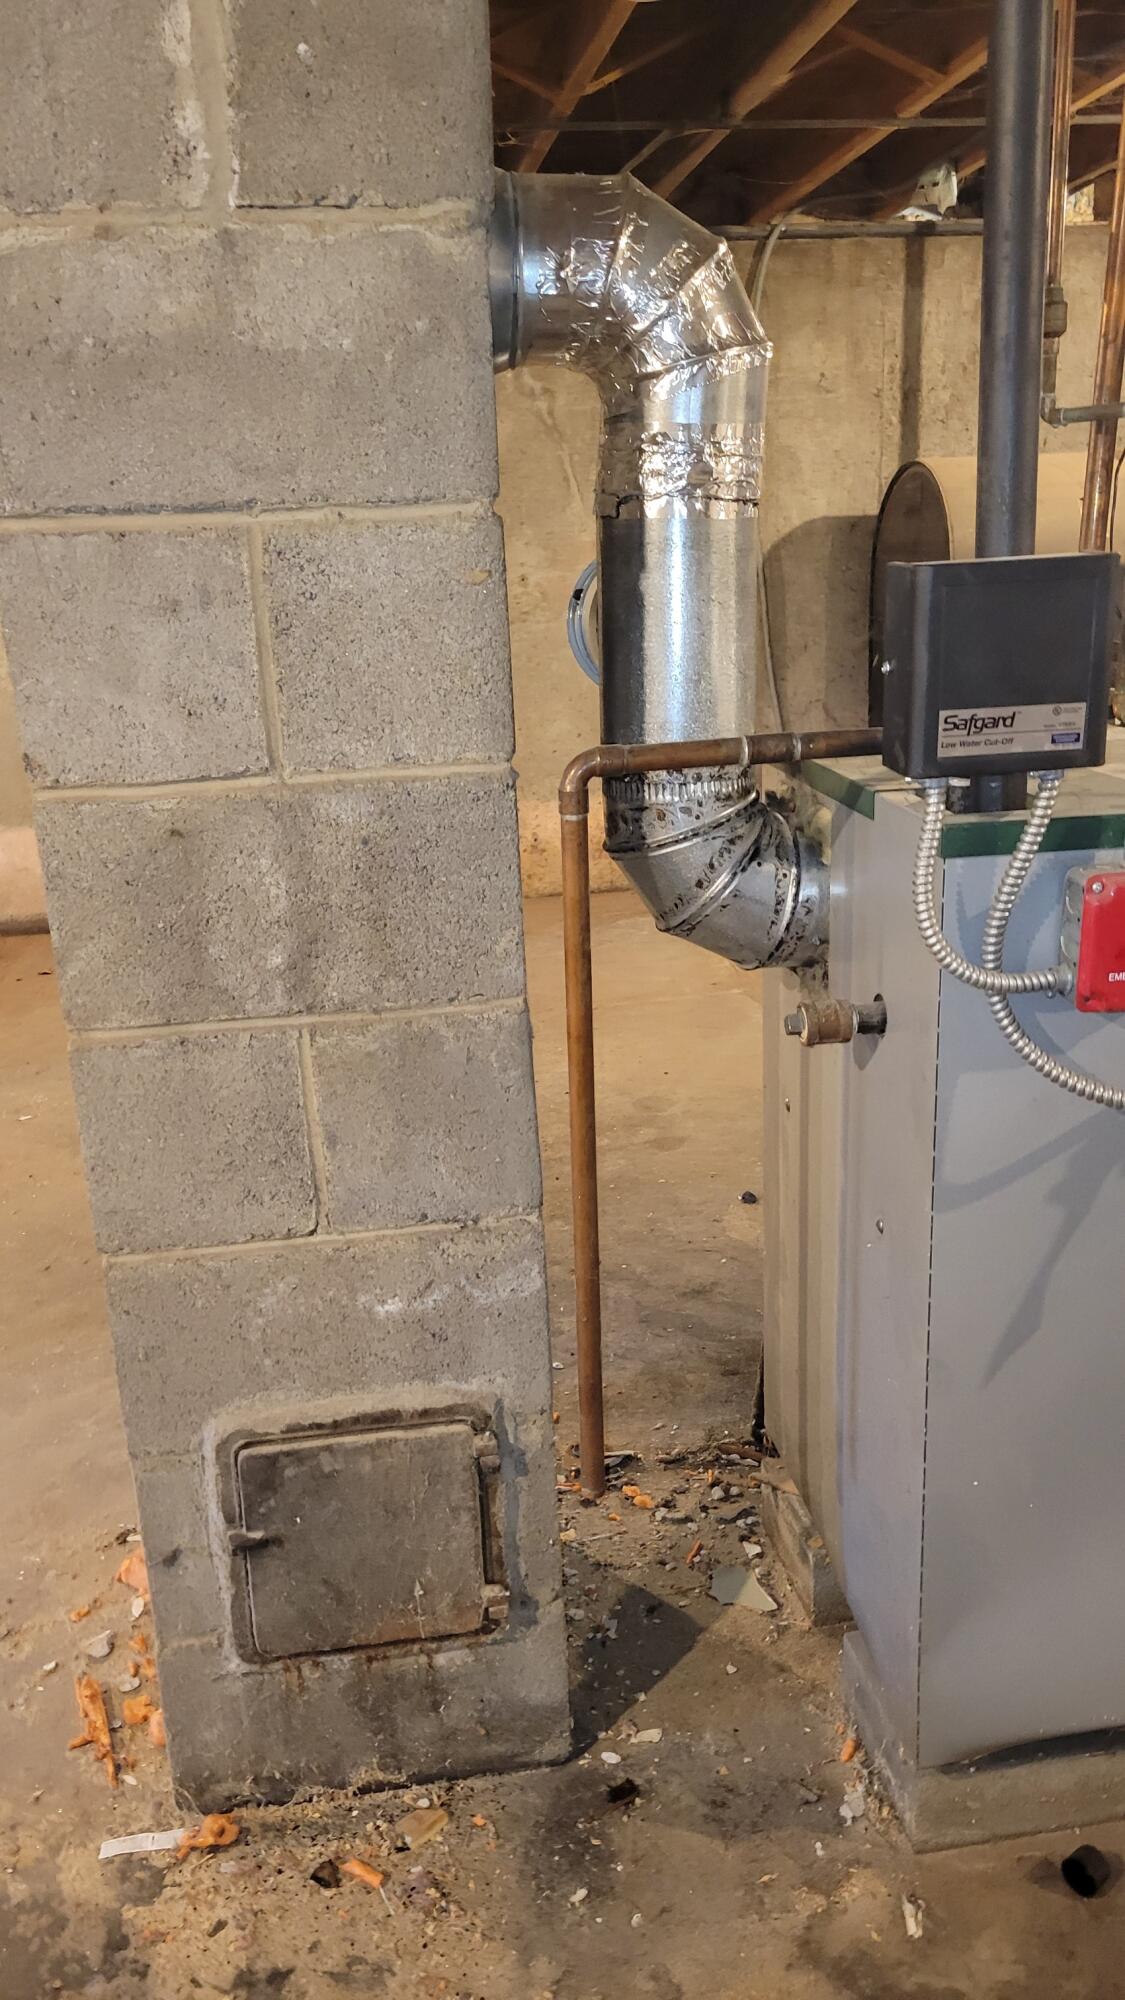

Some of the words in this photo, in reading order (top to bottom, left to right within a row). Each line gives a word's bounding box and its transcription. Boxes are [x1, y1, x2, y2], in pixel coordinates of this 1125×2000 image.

[942, 711, 1016, 736] Safgard
[941, 741, 957, 749] Low
[959, 739, 982, 748] Water
[984, 738, 1014, 746] Cut-Off
